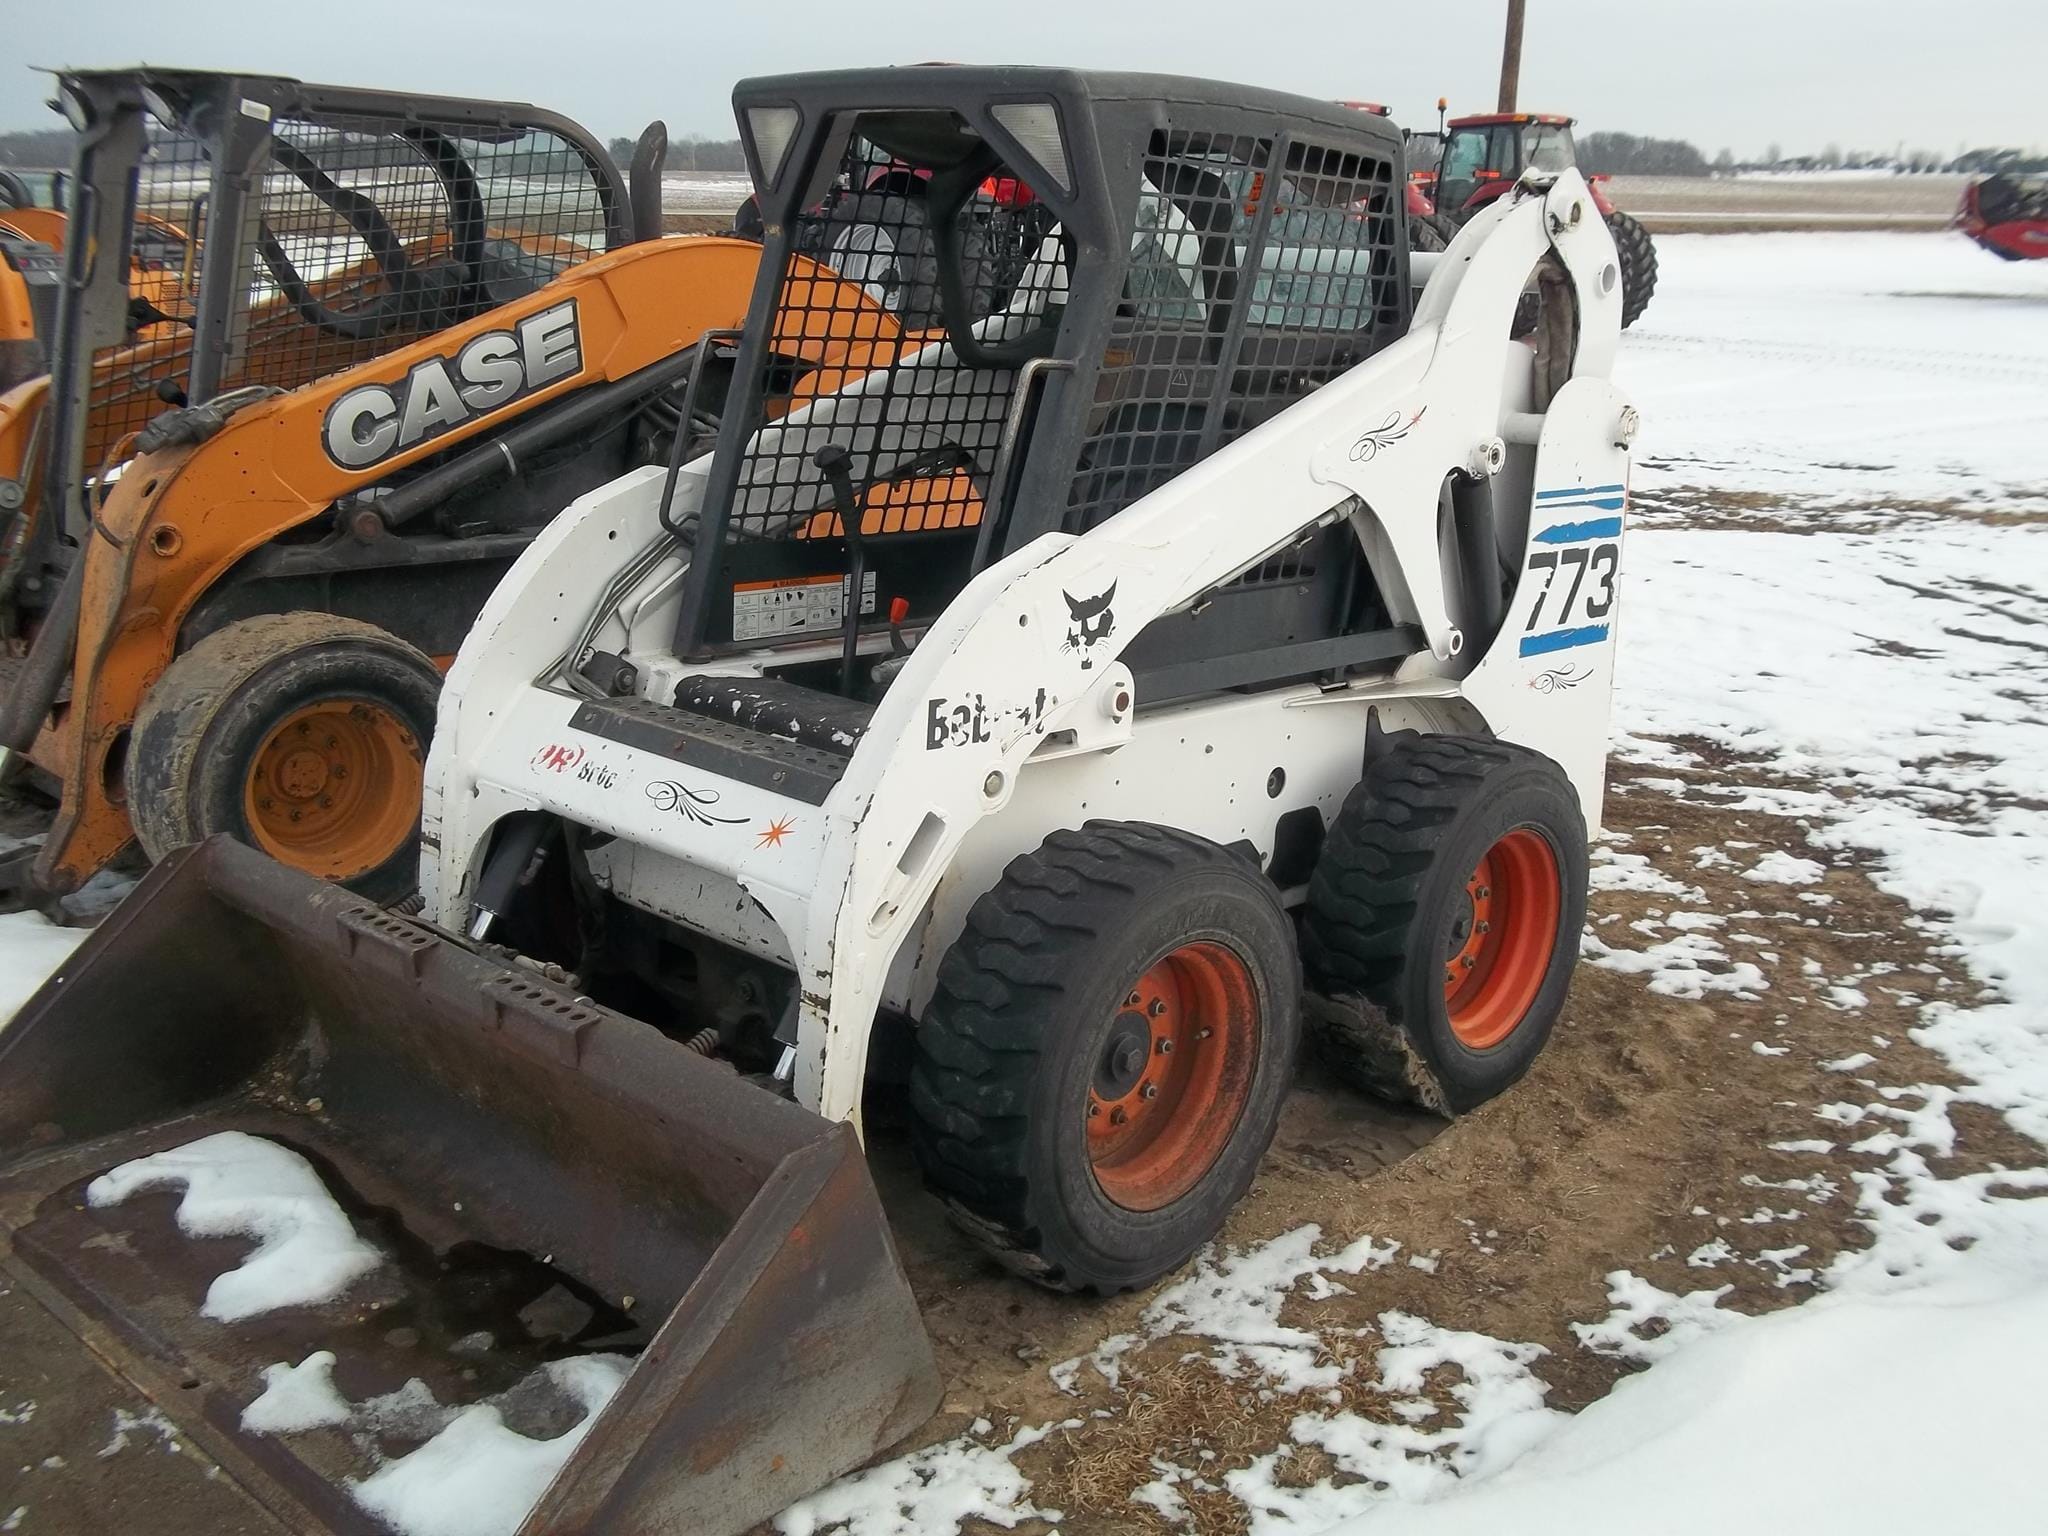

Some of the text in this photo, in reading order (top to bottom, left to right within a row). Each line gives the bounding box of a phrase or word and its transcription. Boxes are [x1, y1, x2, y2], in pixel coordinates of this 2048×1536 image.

[325, 301, 581, 467] CASE
[1525, 543, 1619, 631] 773
[926, 688, 1047, 750] Bobt
